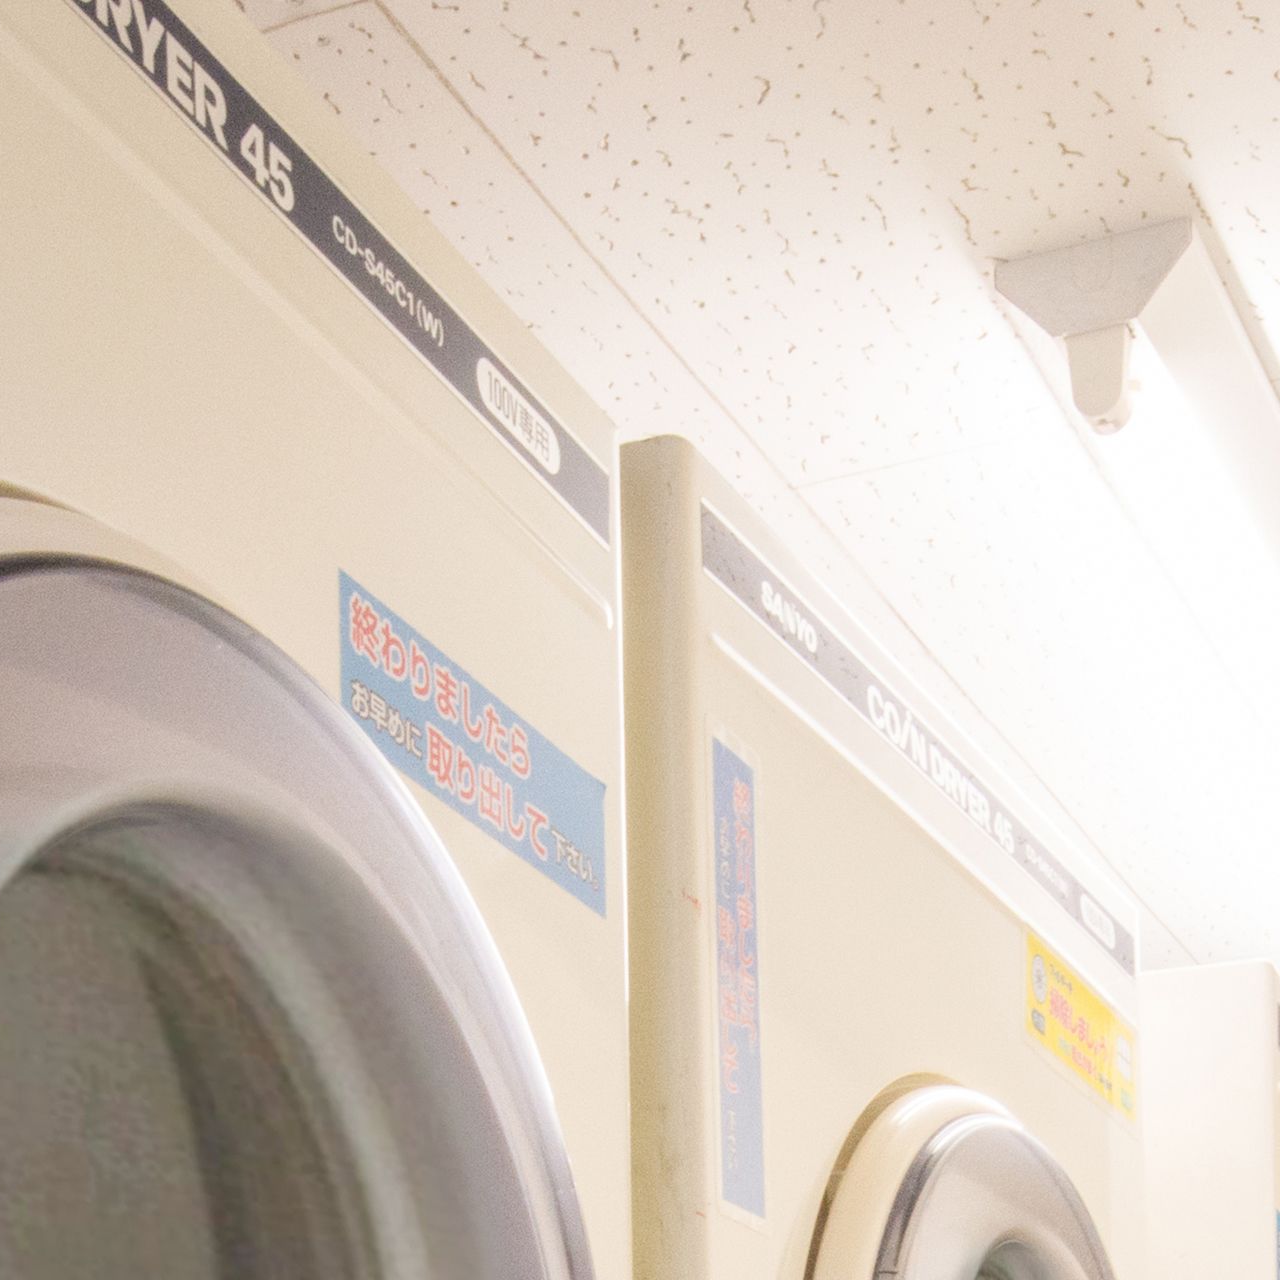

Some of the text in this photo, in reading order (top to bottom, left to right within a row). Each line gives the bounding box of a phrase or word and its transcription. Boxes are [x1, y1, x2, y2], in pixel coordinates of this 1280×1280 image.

[82, 0, 551, 463] RYER 45 CD-S45C1(W) 100V専用
[350, 593, 532, 778] 終わりましたら
[761, 581, 817, 653] SANYO
[928, 748, 993, 834] DRYER
